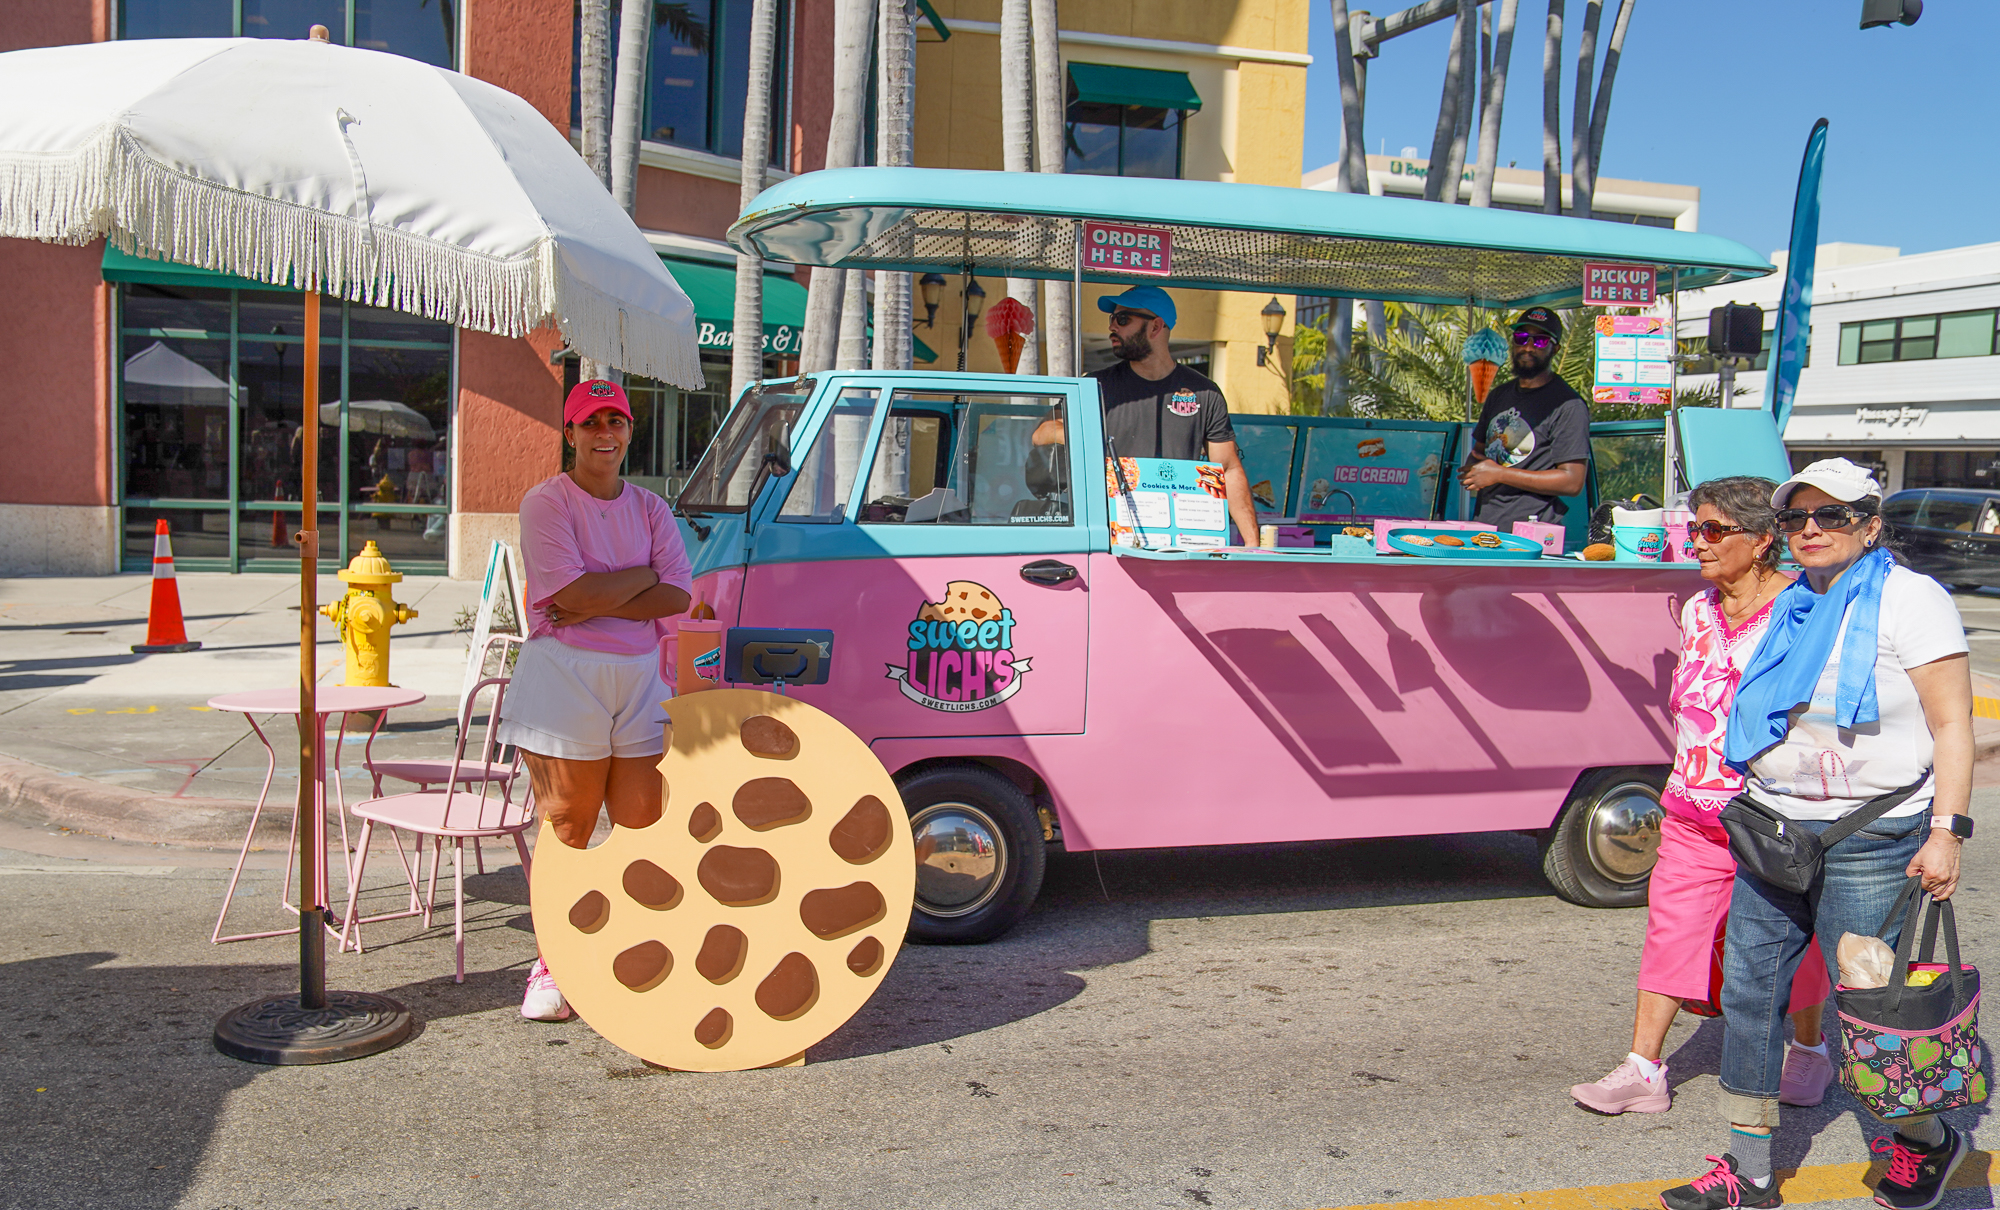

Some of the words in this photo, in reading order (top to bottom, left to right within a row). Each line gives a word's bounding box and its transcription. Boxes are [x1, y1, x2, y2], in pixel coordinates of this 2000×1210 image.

[1092, 229, 1162, 251] ORDER
[698, 322, 770, 349] Bars
[772, 325, 792, 352] &
[1336, 467, 1358, 481] ICE
[1361, 468, 1408, 483] CREAM
[1141, 482, 1170, 490] Cookies
[1010, 515, 1069, 523] SWEETLICHS.COM
[1682, 548, 1697, 559] LIC
[908, 608, 1016, 650] sweet
[908, 650, 1015, 702] LICH'S
[921, 697, 998, 711] SWEETLICHS.COM
